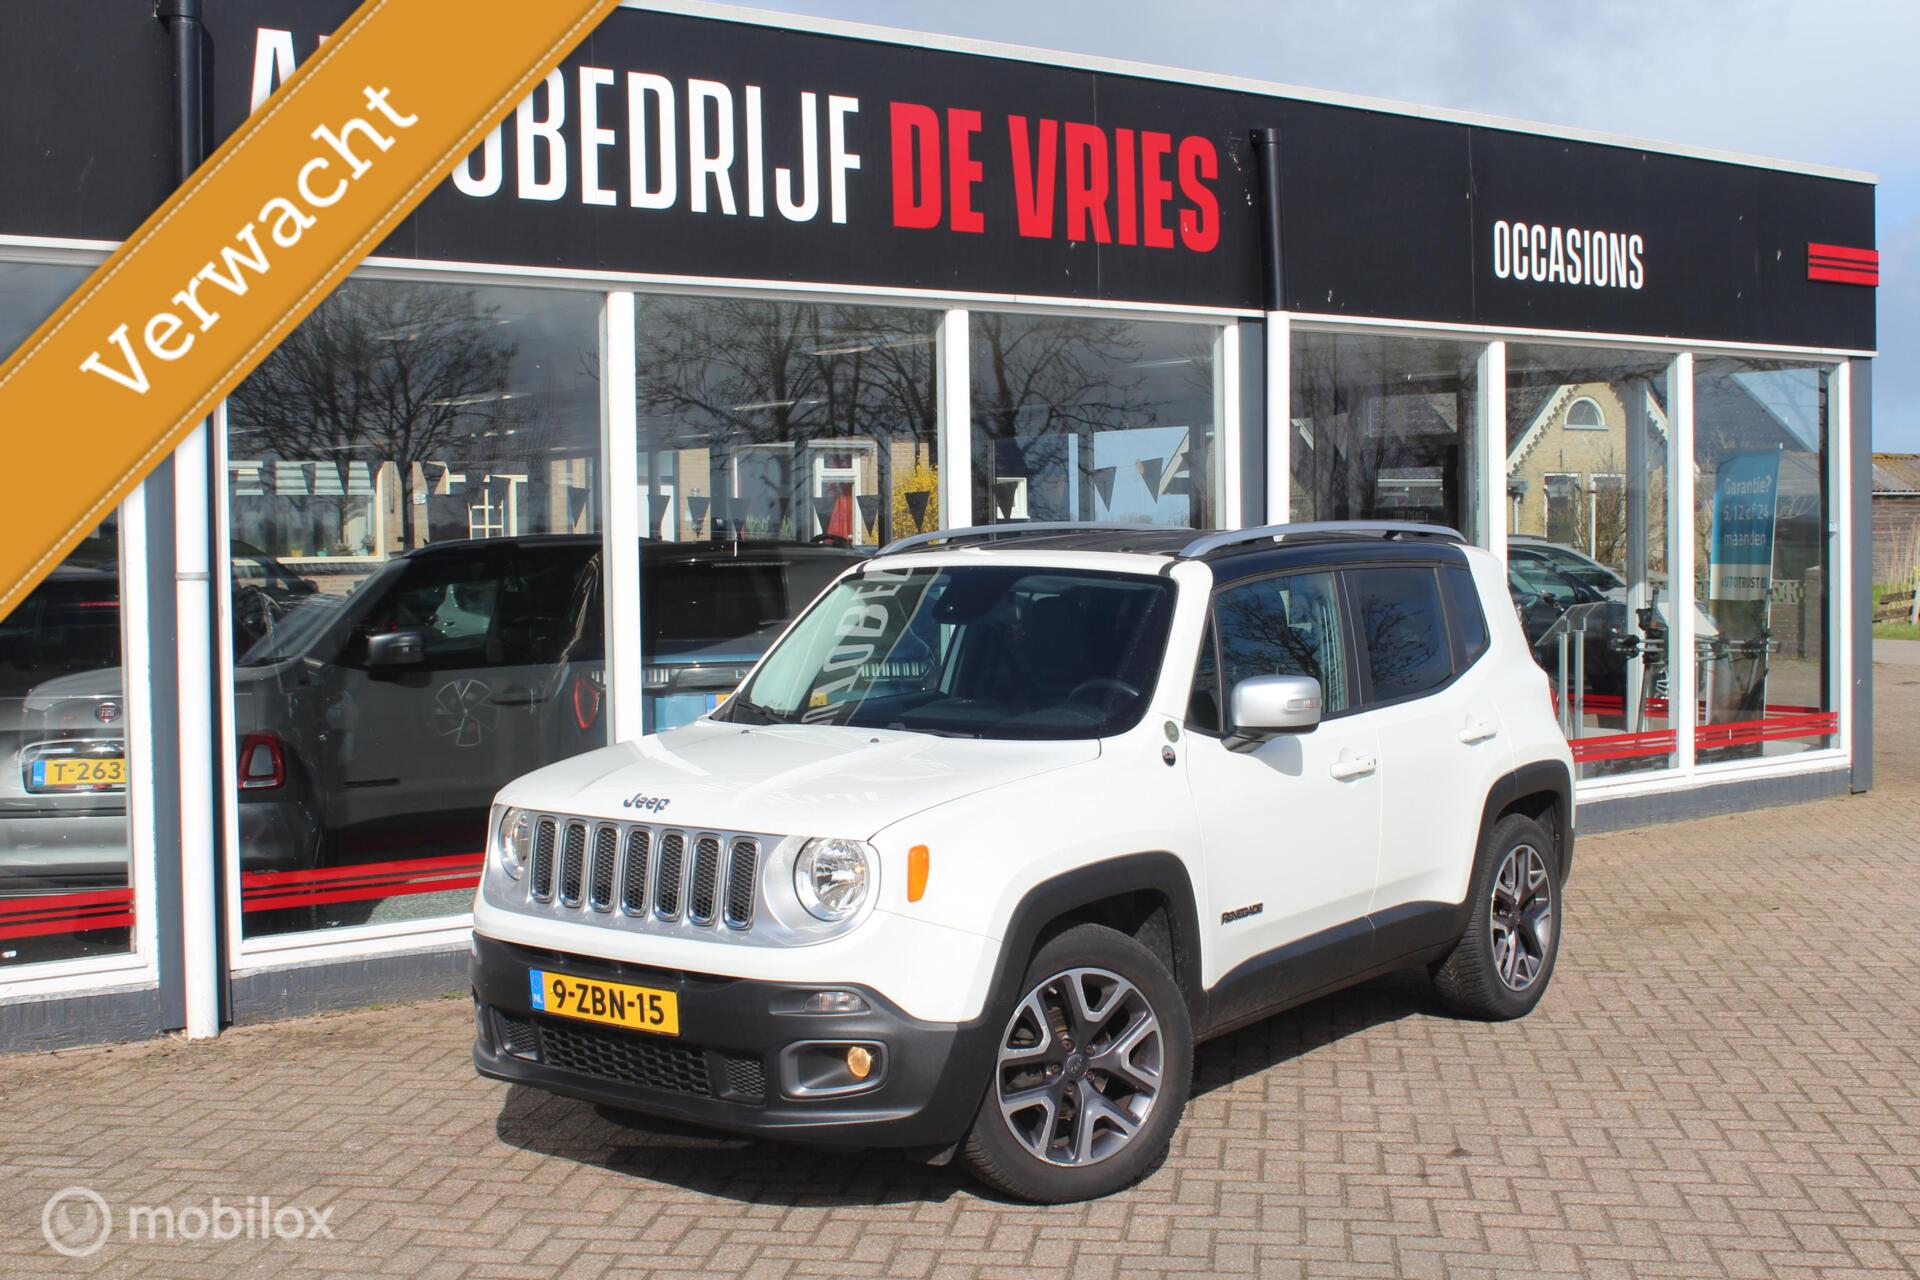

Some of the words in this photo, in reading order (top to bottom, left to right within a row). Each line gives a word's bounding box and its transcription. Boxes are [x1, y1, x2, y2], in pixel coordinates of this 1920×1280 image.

[889, 101, 985, 234] DE
[1007, 114, 1221, 253] VRIES
[1494, 219, 1645, 290] OCCASIONS
[1724, 475, 1772, 495] Garantie?
[1723, 529, 1766, 546] maanden
[100, 707, 116, 717] FIAT
[54, 761, 126, 782] T-263
[623, 792, 671, 814] Jeep
[1220, 902, 1264, 925] RENEGADE
[552, 979, 665, 1026] 9-ZBN-15
